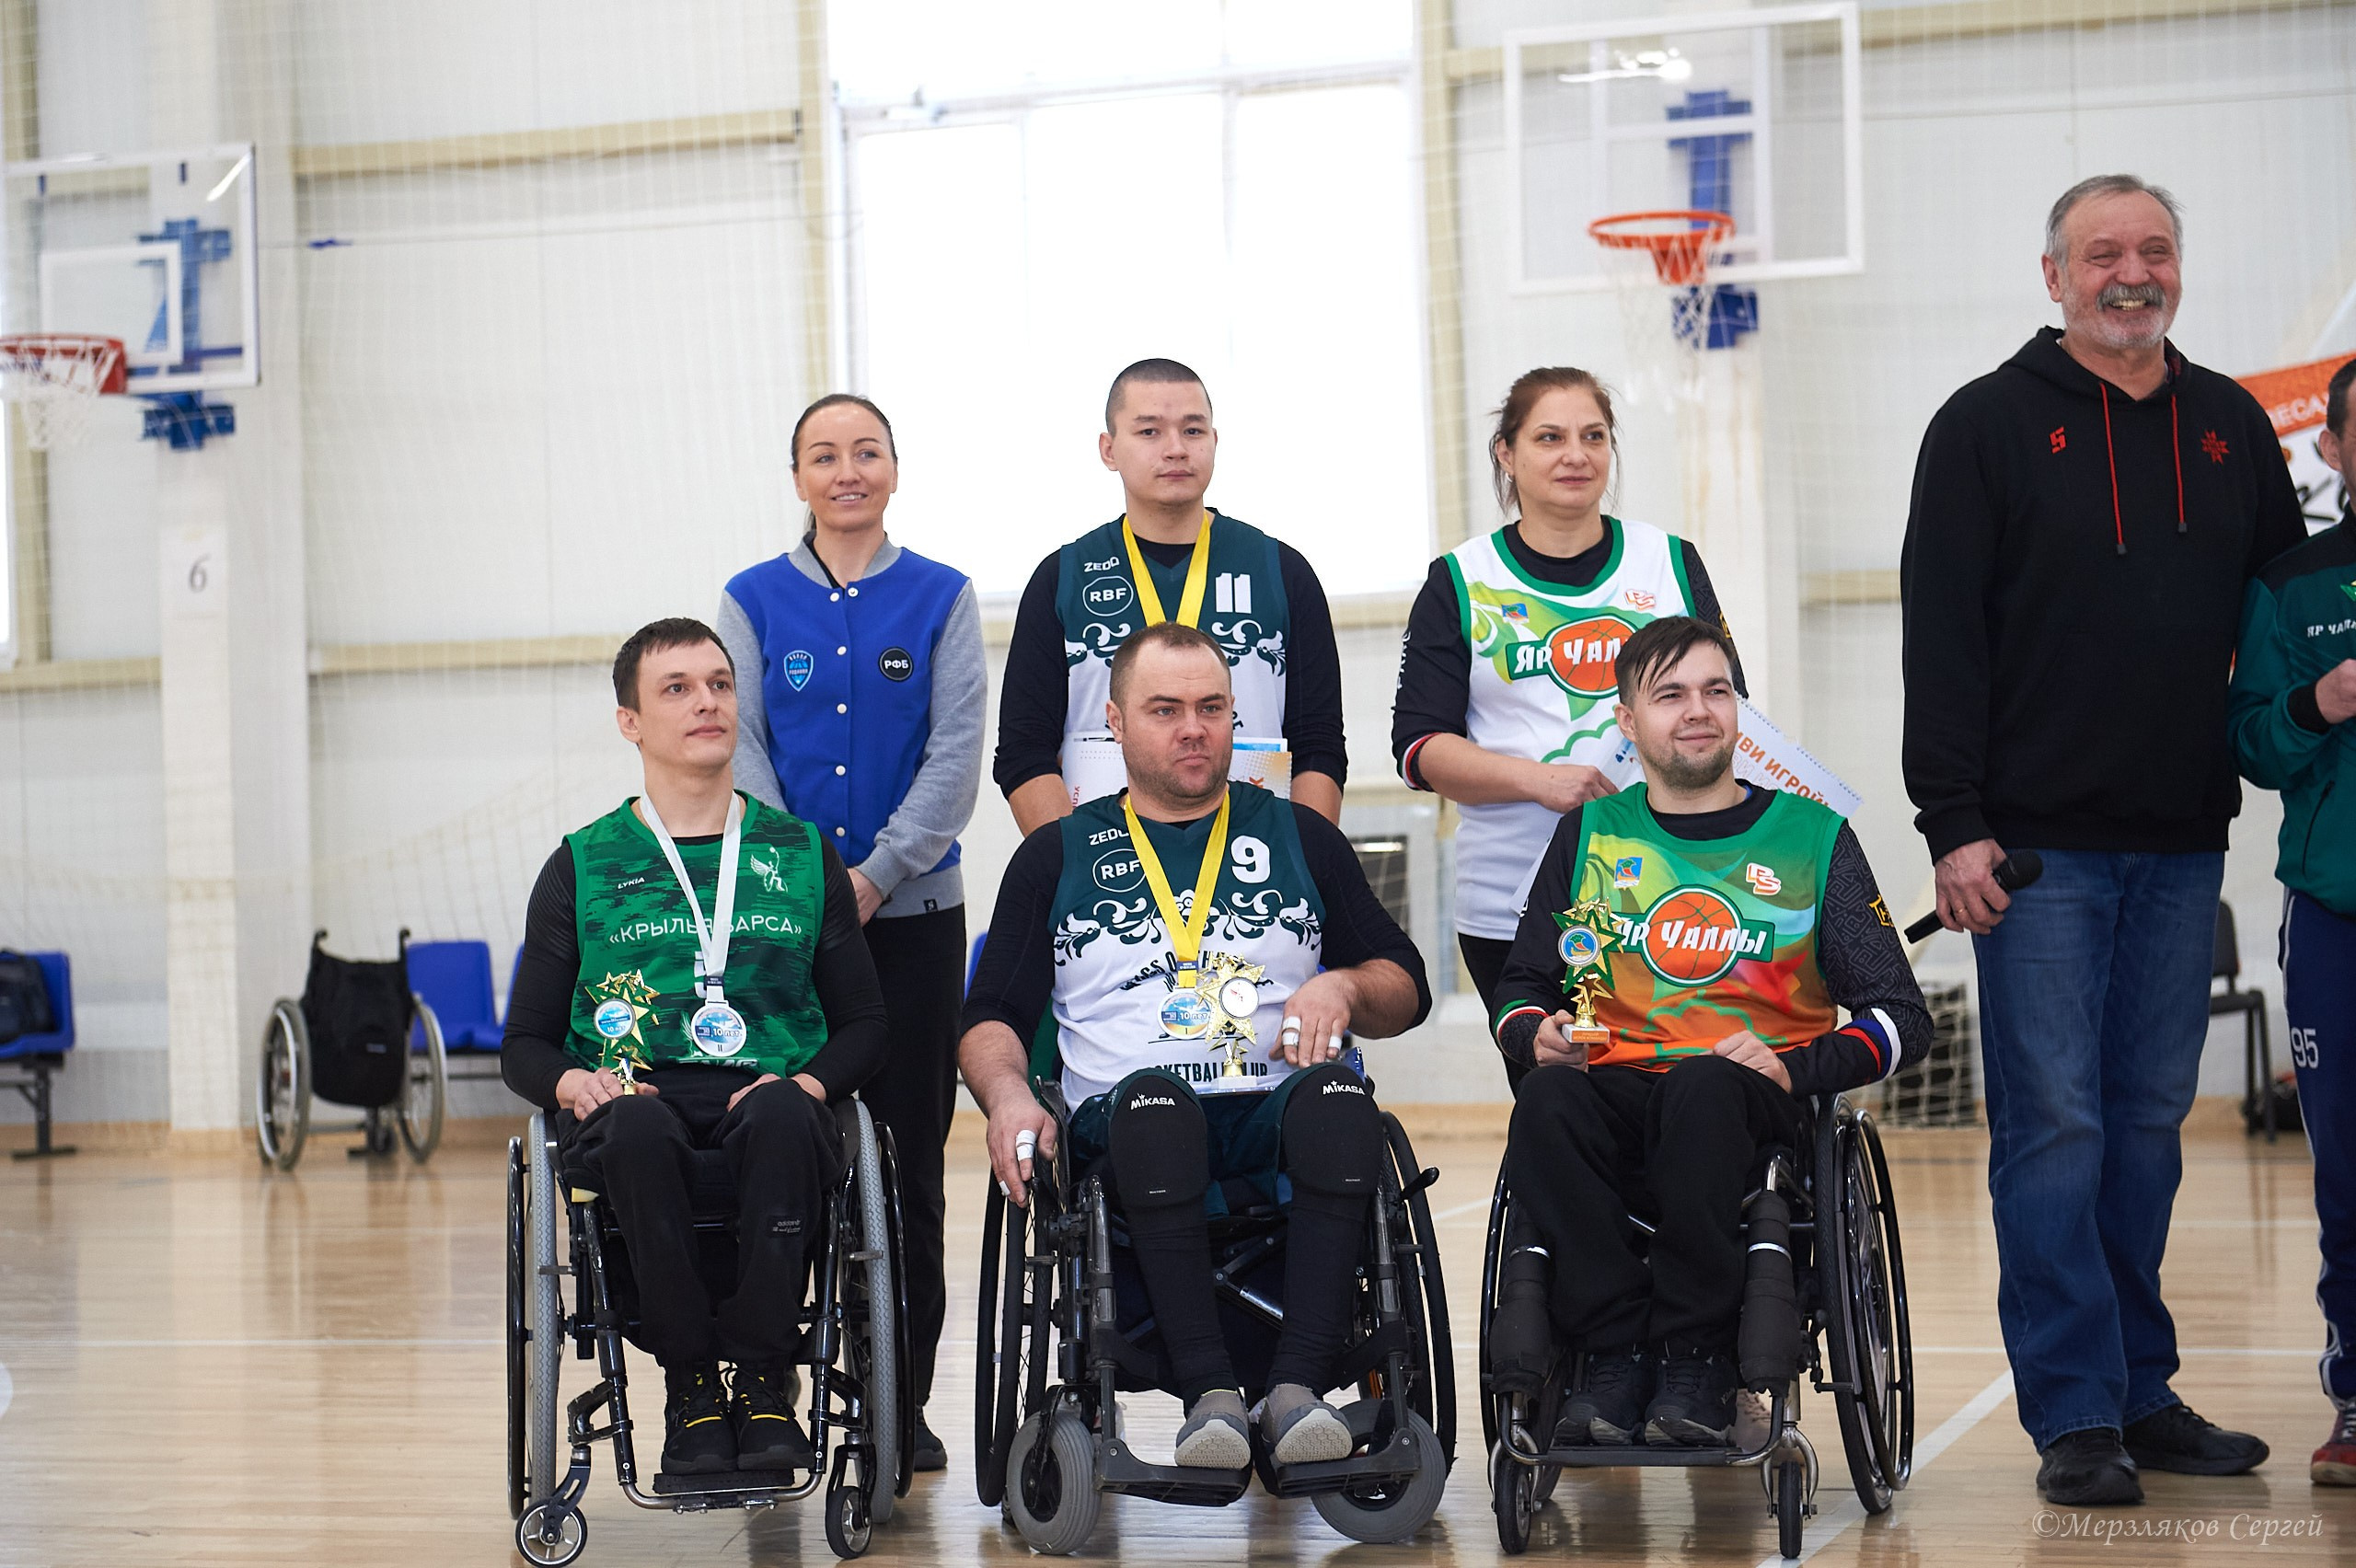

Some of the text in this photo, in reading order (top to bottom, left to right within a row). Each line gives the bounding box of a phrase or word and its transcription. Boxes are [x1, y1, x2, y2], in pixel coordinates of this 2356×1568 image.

[188, 553, 212, 594] 6
[1090, 587, 1127, 603] RBF
[1216, 572, 1252, 614] 11
[2307, 625, 2324, 638] ЯР
[884, 659, 909, 669] РФБ
[1514, 644, 1553, 674] ЯР
[1101, 859, 1140, 880] RBF
[1230, 836, 1271, 883] 9
[618, 877, 645, 890] LYKIA
[1660, 920, 1767, 954] ЧАЛЛЫ
[713, 1028, 724, 1036] 10
[2291, 1027, 2319, 1068] 95
